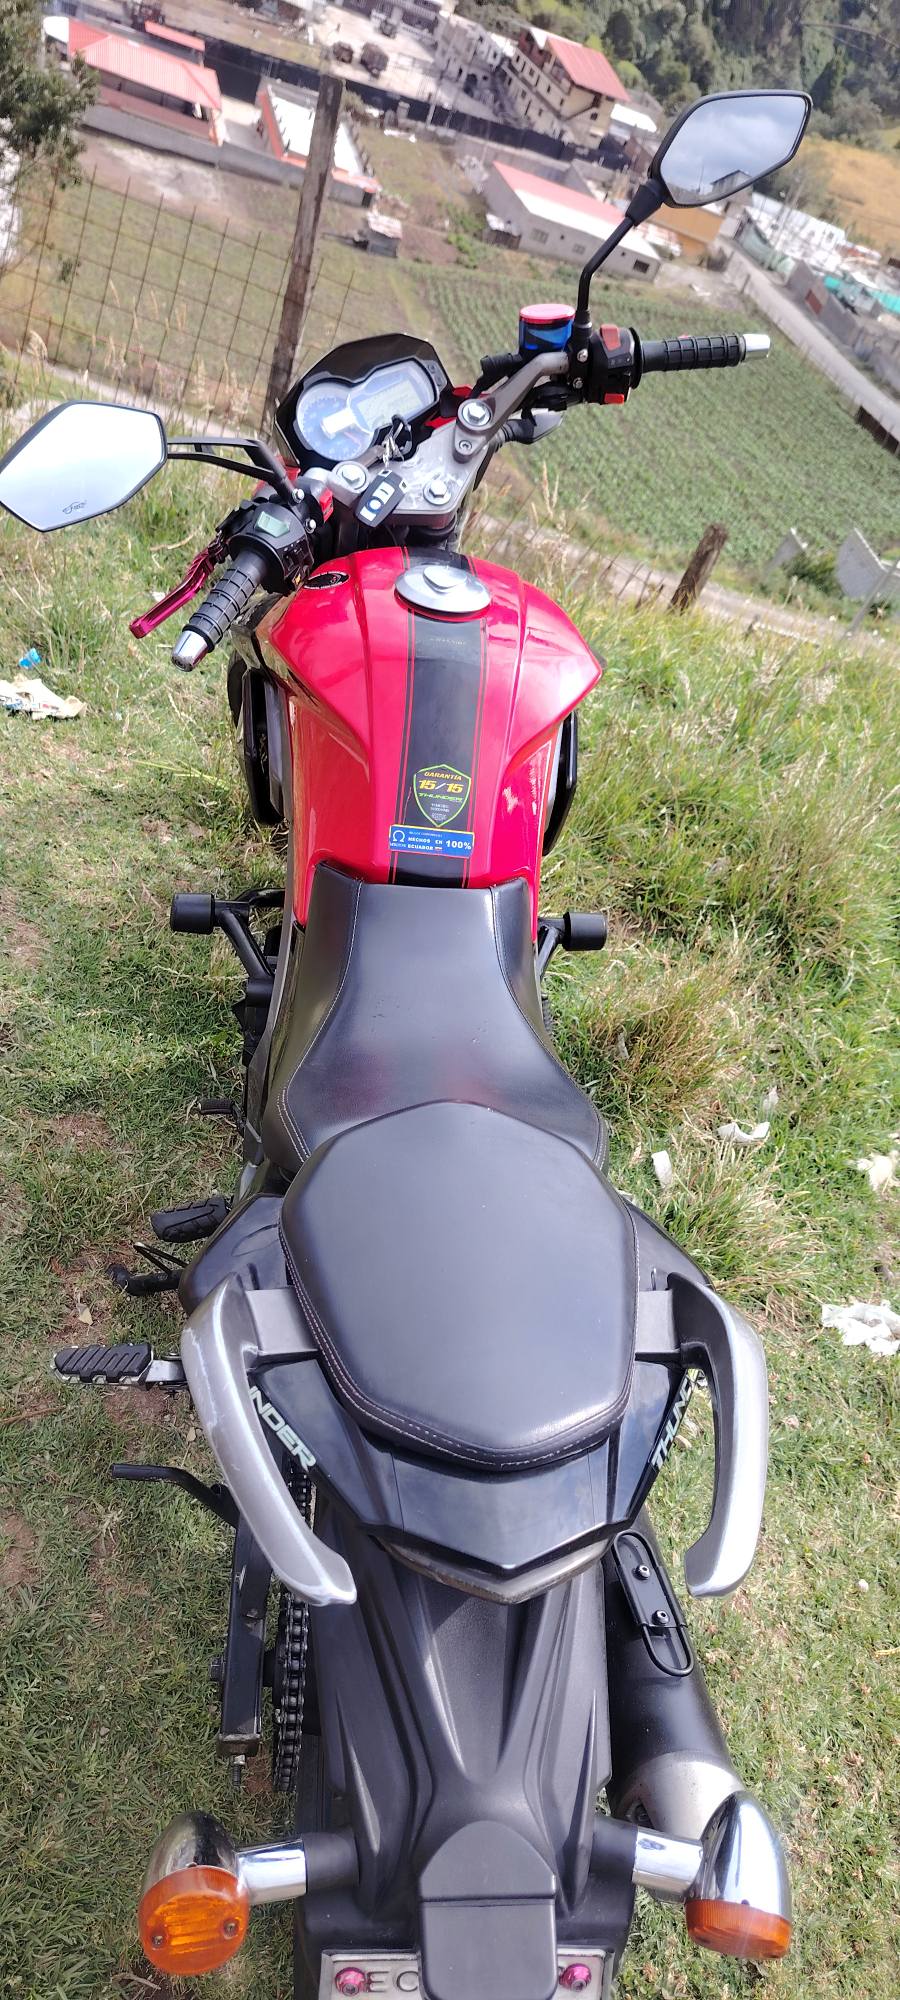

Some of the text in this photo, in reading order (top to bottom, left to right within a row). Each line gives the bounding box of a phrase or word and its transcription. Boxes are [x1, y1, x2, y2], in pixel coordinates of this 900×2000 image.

[418, 780, 464, 794] 15/15
[445, 840, 472, 850] 100%
[248, 1385, 316, 1473] NDER
